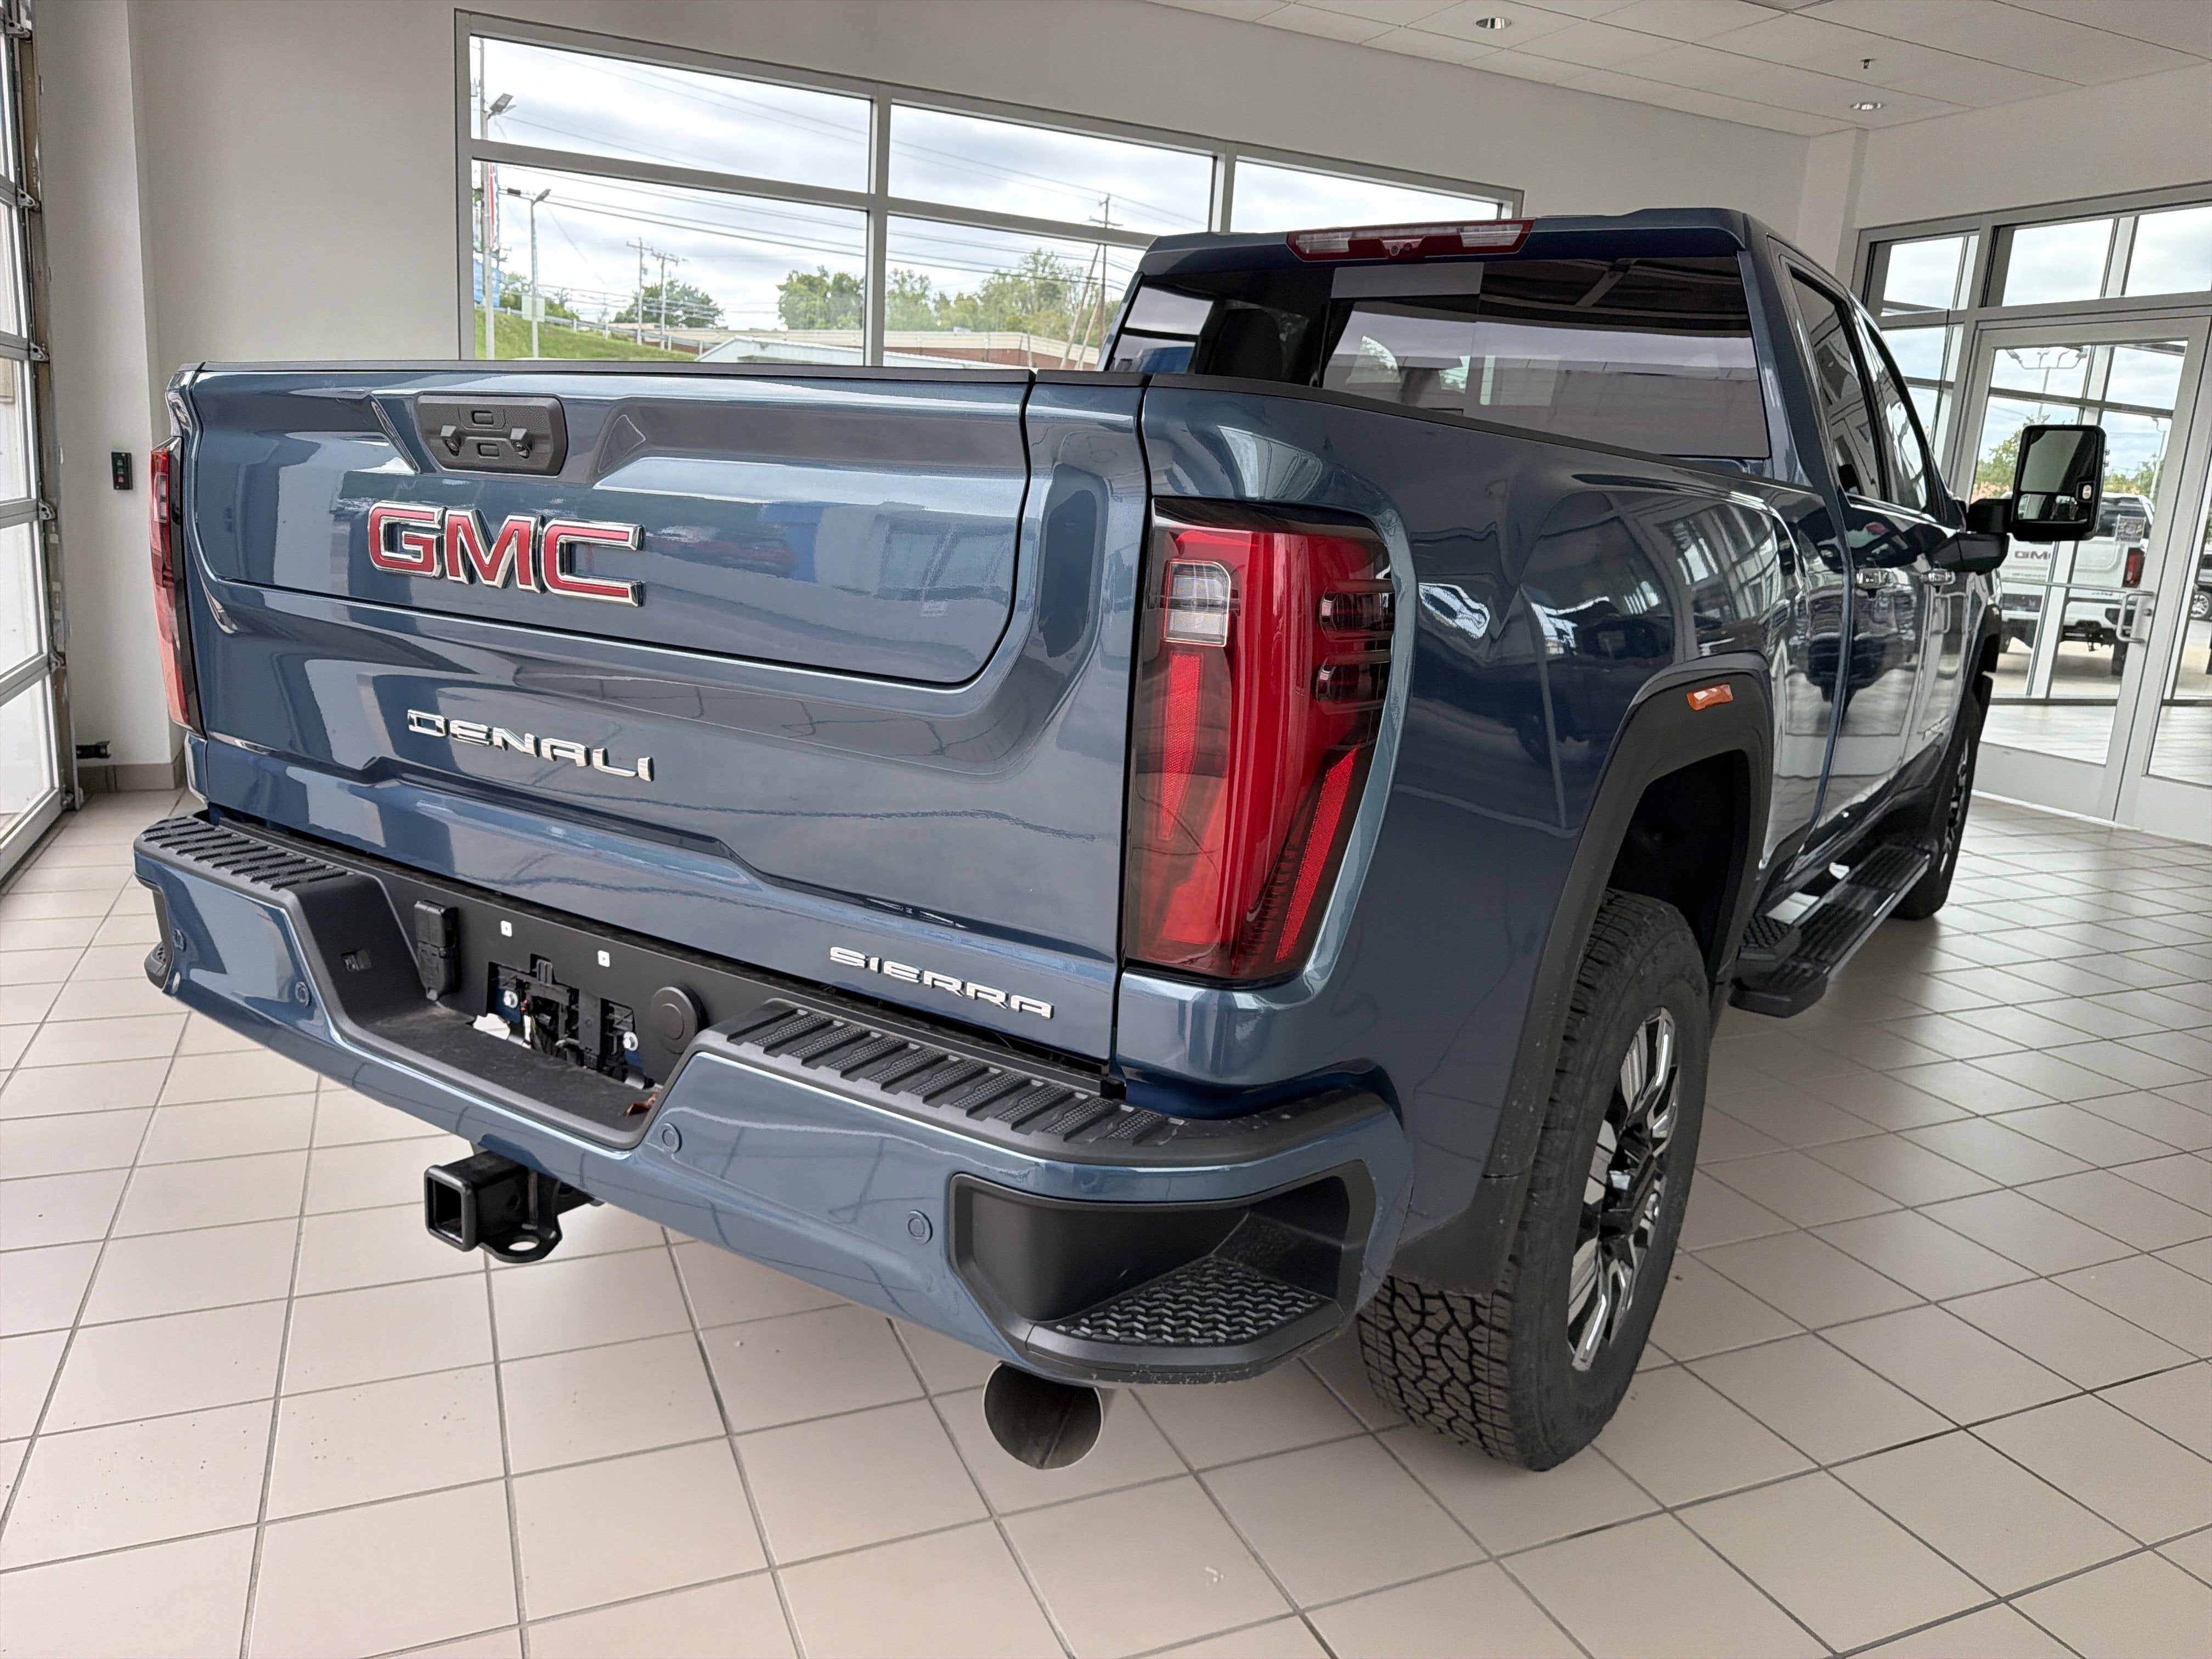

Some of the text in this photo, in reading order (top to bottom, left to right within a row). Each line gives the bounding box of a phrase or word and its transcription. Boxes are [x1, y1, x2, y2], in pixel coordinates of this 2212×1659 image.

[368, 501, 646, 607] GMC
[2015, 550, 2051, 560] GM
[408, 709, 654, 782] DENALI
[830, 946, 1054, 1019] SIERRA
